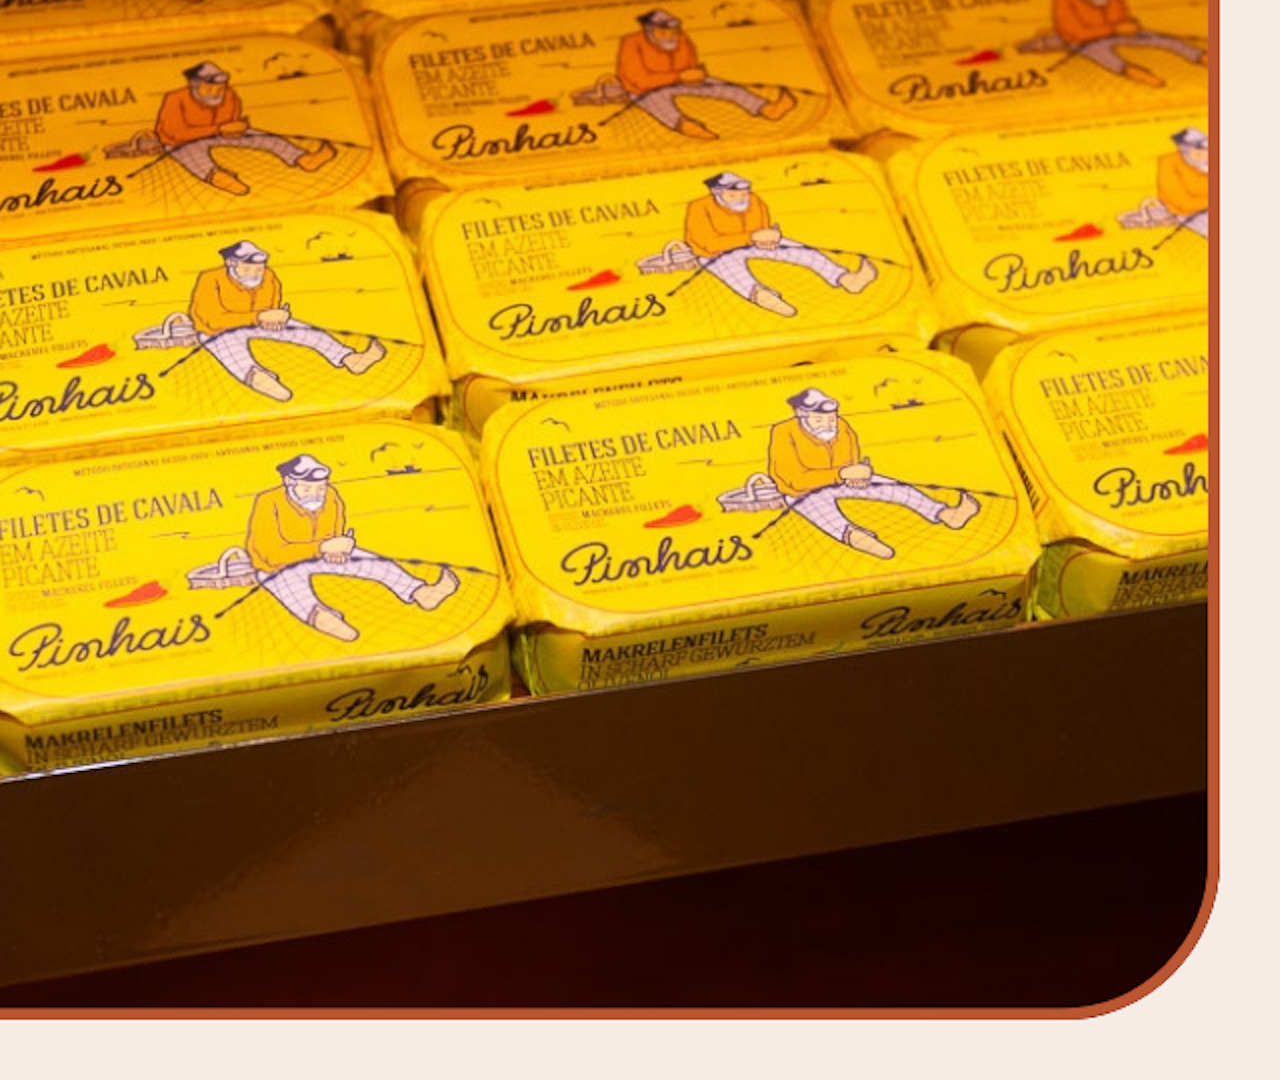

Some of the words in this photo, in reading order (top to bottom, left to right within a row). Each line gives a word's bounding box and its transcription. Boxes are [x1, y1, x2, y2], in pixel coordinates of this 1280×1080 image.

[28, 97, 53, 114] DE
[60, 89, 135, 110] CAVALA
[432, 123, 597, 160] Pinhais
[462, 214, 543, 240] FILETES
[548, 208, 577, 228] DE
[580, 198, 659, 223] CAVALA
[51, 277, 79, 298] DE
[85, 266, 167, 293] CAVALA
[983, 248, 1153, 292] Pinhais
[489, 295, 664, 341] Pinhais
[1037, 369, 1124, 397] FILETES
[1124, 363, 1158, 385] DE
[527, 438, 616, 467] FILETES
[620, 432, 652, 454] DE
[655, 421, 741, 449] CAVALA
[533, 467, 569, 489] EM
[575, 456, 647, 485] AZEITE
[96, 501, 127, 526] DE
[134, 489, 222, 520] CAVALA
[540, 481, 635, 511] PICANTE
[0, 541, 33, 565] EM
[40, 528, 117, 560] AZEITE
[561, 535, 751, 586] Pinhais
[2, 556, 99, 589] PICANTE
[9, 615, 209, 671] Pinhais
[581, 623, 769, 663] MAKRELENFILETS
[861, 597, 1022, 640] Pinhais
[24, 709, 223, 750] MAKRELENFILETS
